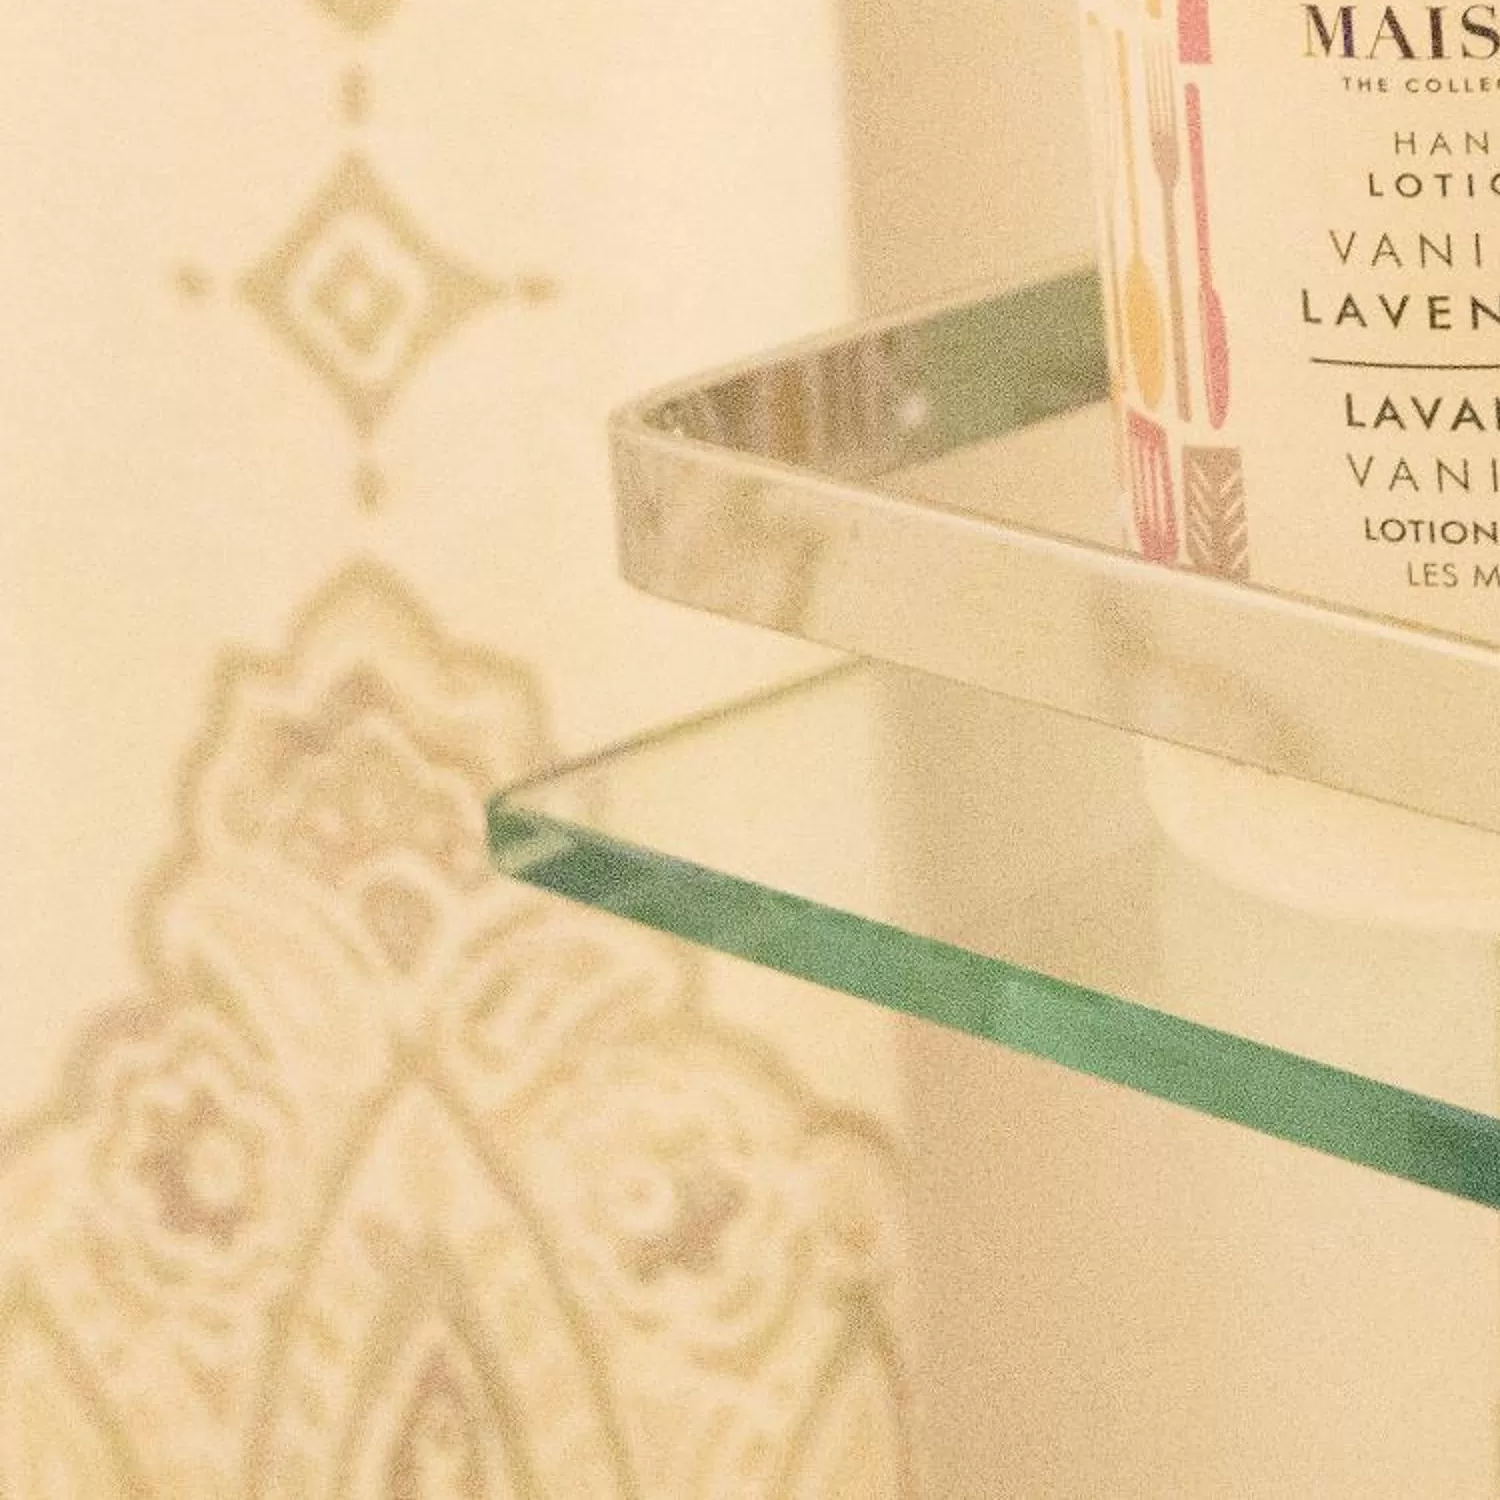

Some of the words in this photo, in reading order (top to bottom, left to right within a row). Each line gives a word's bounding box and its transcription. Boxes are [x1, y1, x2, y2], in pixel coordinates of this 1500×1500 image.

[1343, 76, 1389, 93] THE
[1365, 516, 1499, 545] LOTION
[1407, 562, 1458, 588] LES
